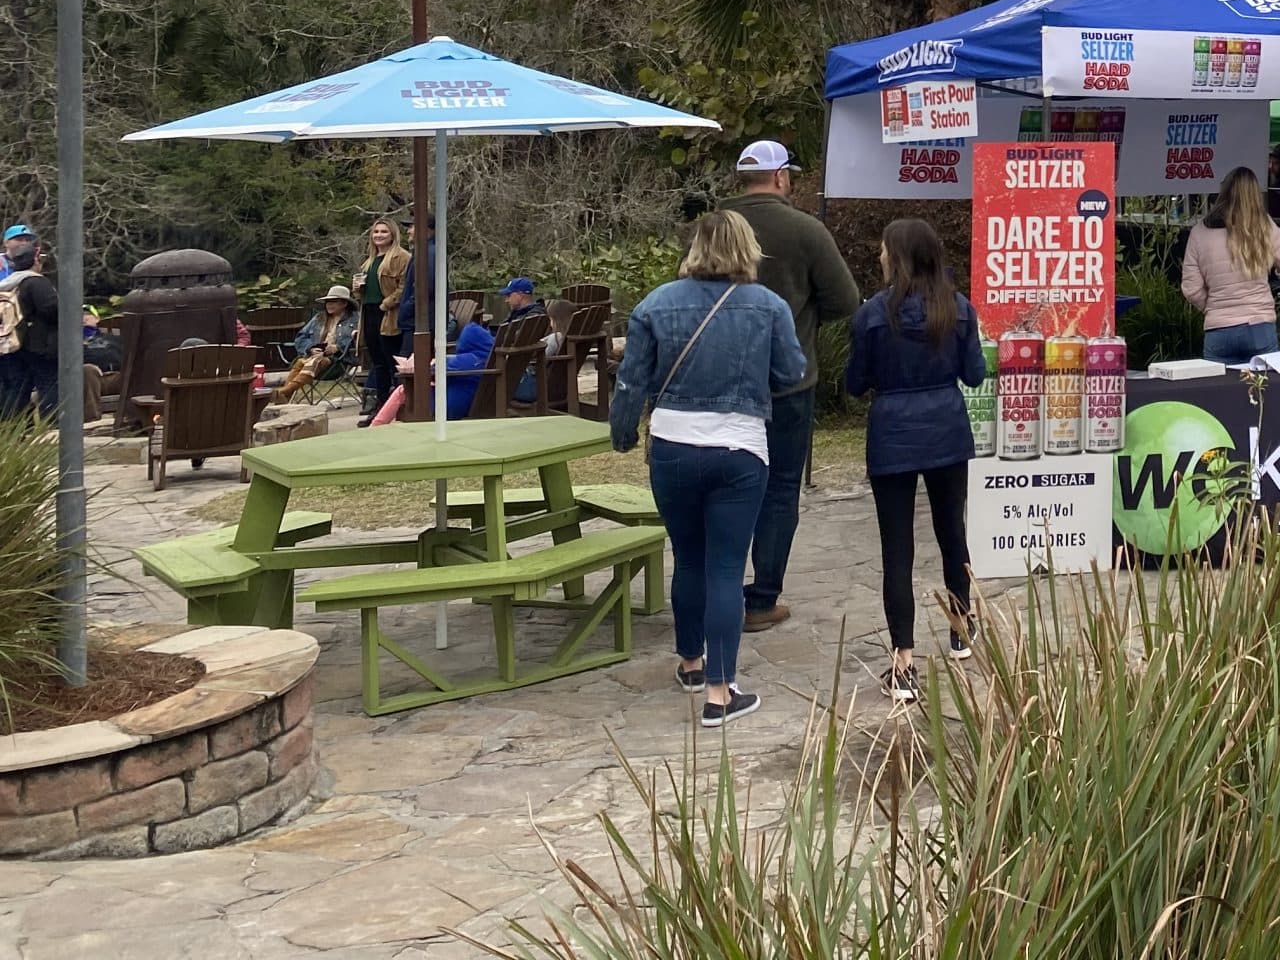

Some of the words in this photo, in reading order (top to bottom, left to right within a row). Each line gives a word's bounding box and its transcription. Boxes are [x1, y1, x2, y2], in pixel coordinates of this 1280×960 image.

[1081, 32, 1103, 40] BUD
[1104, 33, 1134, 41] LIGHT
[880, 47, 912, 75] BUD
[911, 40, 953, 67] LIGHT
[1081, 41, 1134, 61] SELTZER
[1085, 62, 1131, 77] HARD
[414, 80, 493, 89] BUD
[1083, 76, 1130, 91] SODA
[400, 88, 510, 98] LIGHT
[923, 87, 947, 106] First
[948, 84, 975, 103] Pour
[412, 96, 507, 109] SELTZER
[930, 107, 970, 129] Station
[1168, 114, 1188, 124] BUD
[1189, 114, 1219, 123] LIGHT
[1165, 124, 1217, 145] SELTZER
[901, 148, 960, 166] HARD
[1007, 149, 1039, 160] BUD
[1040, 149, 1084, 160] LIGHT
[1166, 147, 1214, 163] HARD
[898, 166, 959, 183] SODA
[1005, 160, 1085, 188] SELTZER
[1165, 163, 1214, 179] SODA
[1080, 201, 1107, 211] NEW
[987, 216, 1060, 250] DARE
[1068, 216, 1104, 249] TO
[986, 251, 1104, 287] SELTZER
[986, 289, 1104, 304] DIFFERENTLY
[999, 374, 1043, 394] SELTZER
[1002, 397, 1040, 409] HARD
[1047, 396, 1082, 407] HARD
[1088, 396, 1122, 407] HARD
[1002, 409, 1040, 422] SODA
[1047, 407, 1082, 419] SODA
[1088, 407, 1122, 418] SODA
[984, 475, 1029, 489] ZERO
[1040, 474, 1087, 486] SUGAR
[1003, 505, 1022, 519] 5%
[1027, 503, 1074, 519] Alc/Vol
[992, 536, 1015, 550] 100
